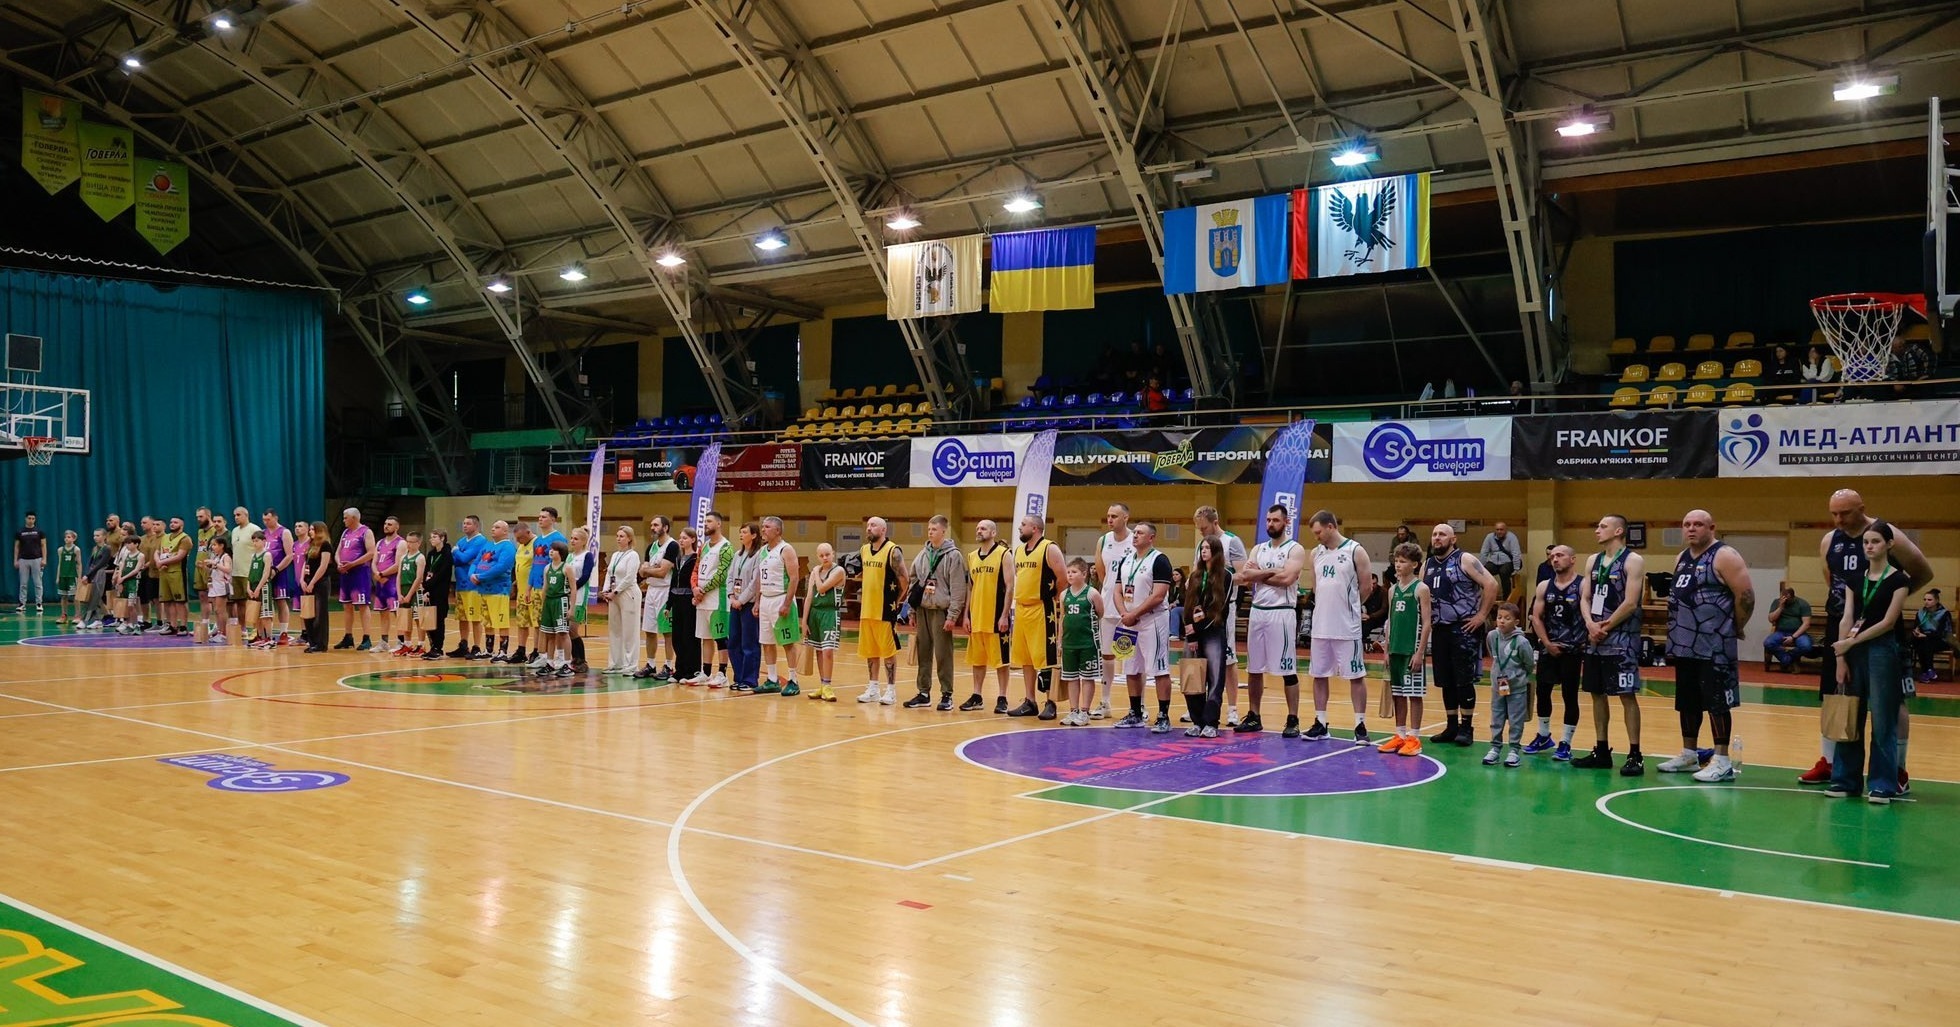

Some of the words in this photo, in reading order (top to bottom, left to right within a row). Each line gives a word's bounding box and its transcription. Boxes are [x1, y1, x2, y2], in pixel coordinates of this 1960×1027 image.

[1556, 428, 1668, 448] FRANKOF
[1779, 424, 1960, 450] МЕД-АТЛАНТ
[1198, 450, 1261, 460] ГЕРОЯМ
[1384, 440, 1481, 461] Socium
[825, 452, 885, 466] FRANKOF
[946, 452, 1012, 470] Socium
[1054, 455, 1079, 464] АВА
[1087, 452, 1150, 464] УКРАЇНІ!
[1782, 452, 1921, 464] лікувально-діагностичний
[1927, 452, 1958, 461] центр
[1432, 461, 1480, 474] developer
[980, 469, 1012, 481] developer
[698, 499, 706, 548] ocium
[1844, 555, 1857, 570] 18
[762, 568, 768, 580] 15
[1323, 566, 1335, 578] 84
[1433, 576, 1440, 589] 11
[1676, 574, 1691, 588] 83
[280, 588, 286, 597] 11
[358, 593, 365, 602] 13
[469, 607, 474, 615] 5
[1068, 604, 1080, 614] 35
[1395, 600, 1406, 612] 96
[499, 614, 504, 622] 7
[715, 622, 724, 634] 12
[781, 628, 791, 640] 15
[824, 631, 836, 640] 75
[1086, 660, 1097, 670] 35
[1158, 659, 1165, 670] 11
[1281, 658, 1293, 670] 32
[1351, 659, 1363, 673] 84
[1619, 673, 1634, 687] 69
[1902, 677, 1915, 694] 18
[170, 756, 302, 785] Socium
